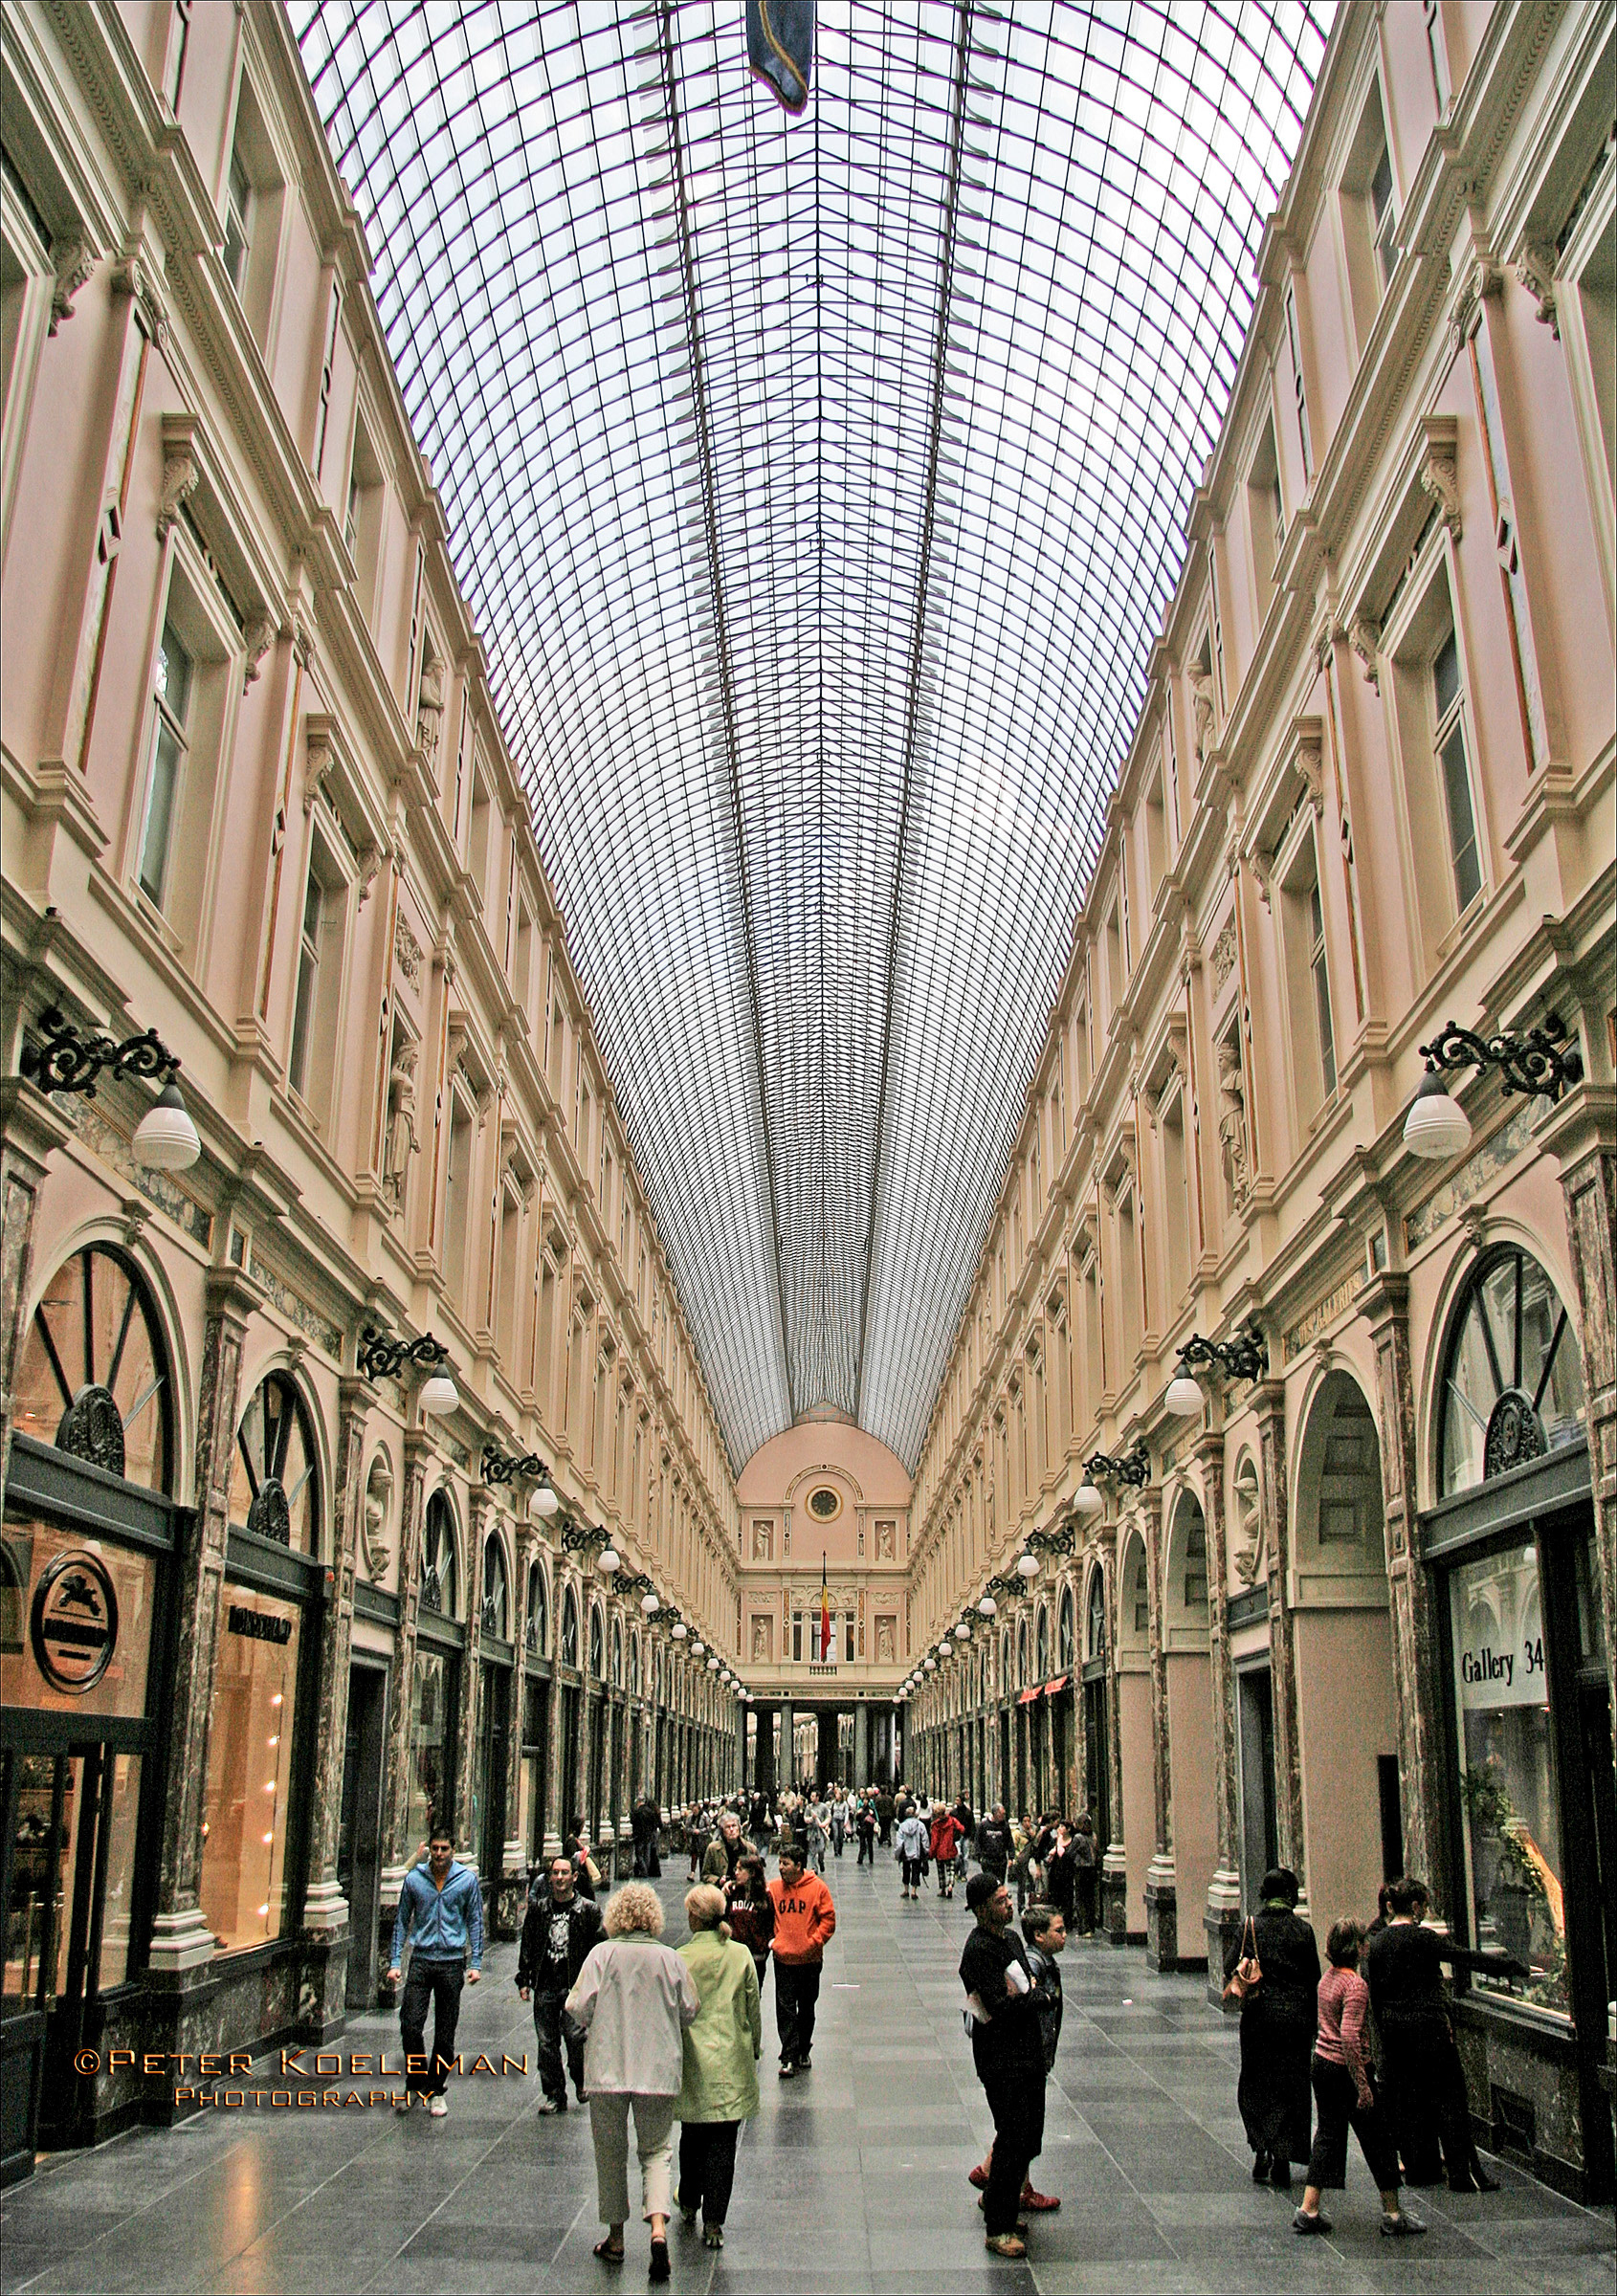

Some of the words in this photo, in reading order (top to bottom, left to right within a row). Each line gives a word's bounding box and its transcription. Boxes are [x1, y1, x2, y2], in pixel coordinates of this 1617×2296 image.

[1462, 1646, 1514, 1687] Gallery
[1524, 1637, 1544, 1674] 34
[779, 1898, 807, 1914] GAP
